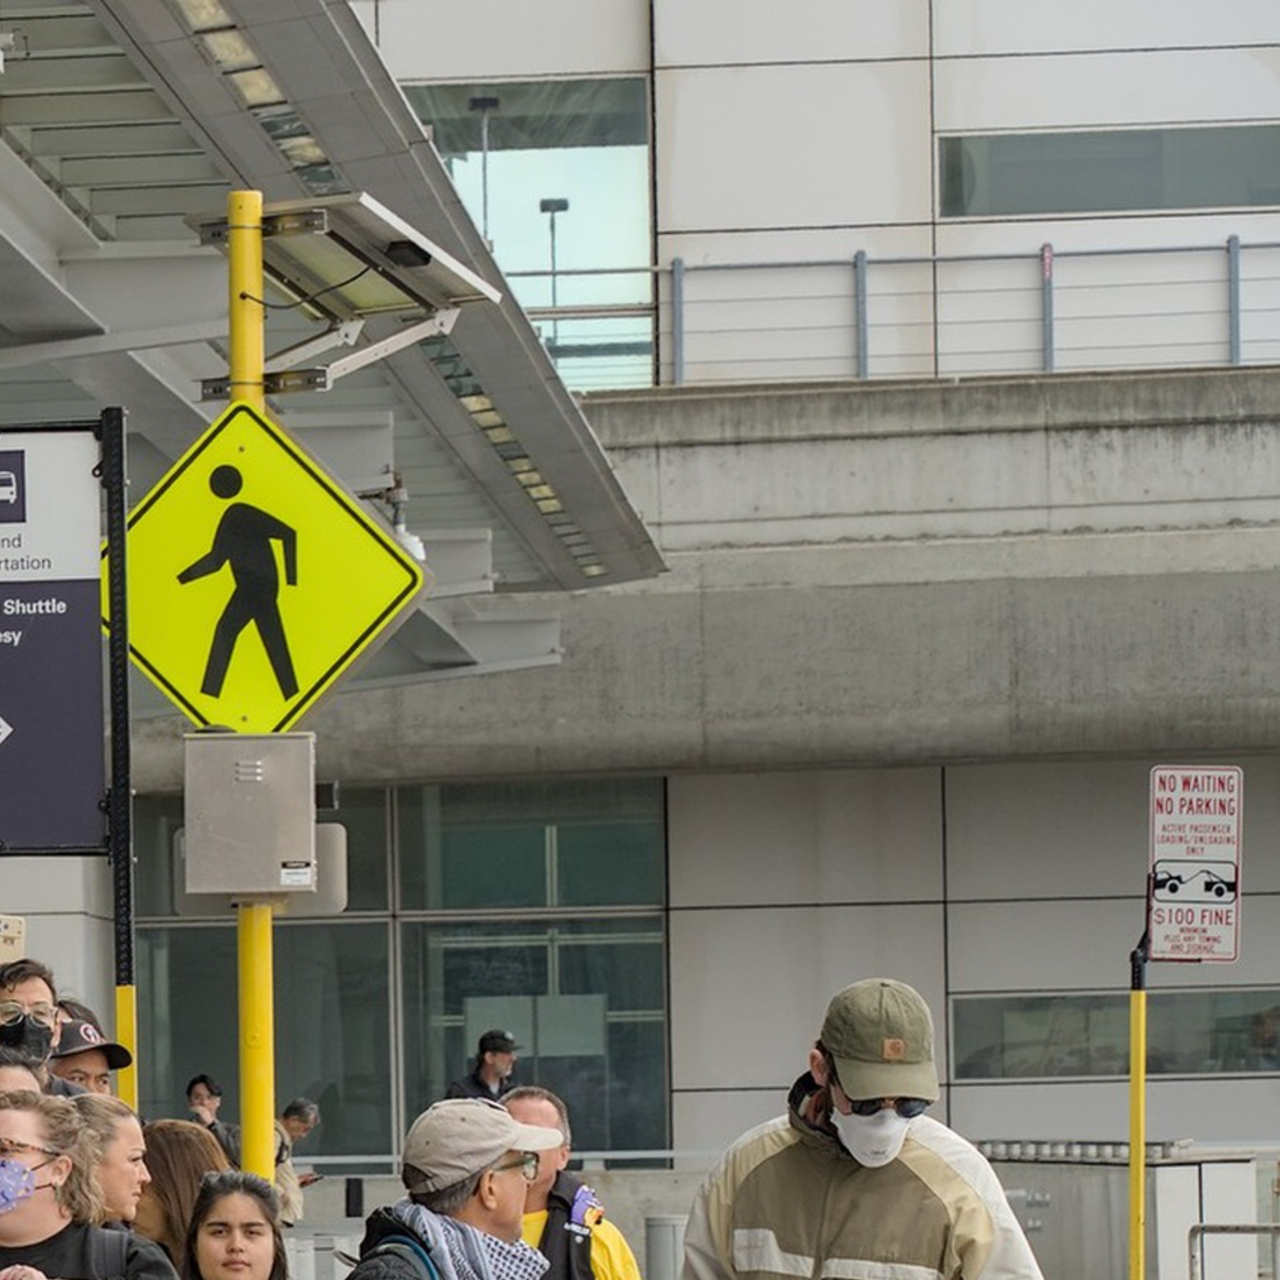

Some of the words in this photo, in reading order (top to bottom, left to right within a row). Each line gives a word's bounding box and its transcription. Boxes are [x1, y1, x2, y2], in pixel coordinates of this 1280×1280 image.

[3, 598, 67, 615] Shuttle
[1158, 774, 1177, 793] NO
[1181, 775, 1235, 793] WAITING
[1156, 797, 1174, 815] NO
[1179, 798, 1236, 816] PARKING
[1200, 908, 1234, 926] FINE
